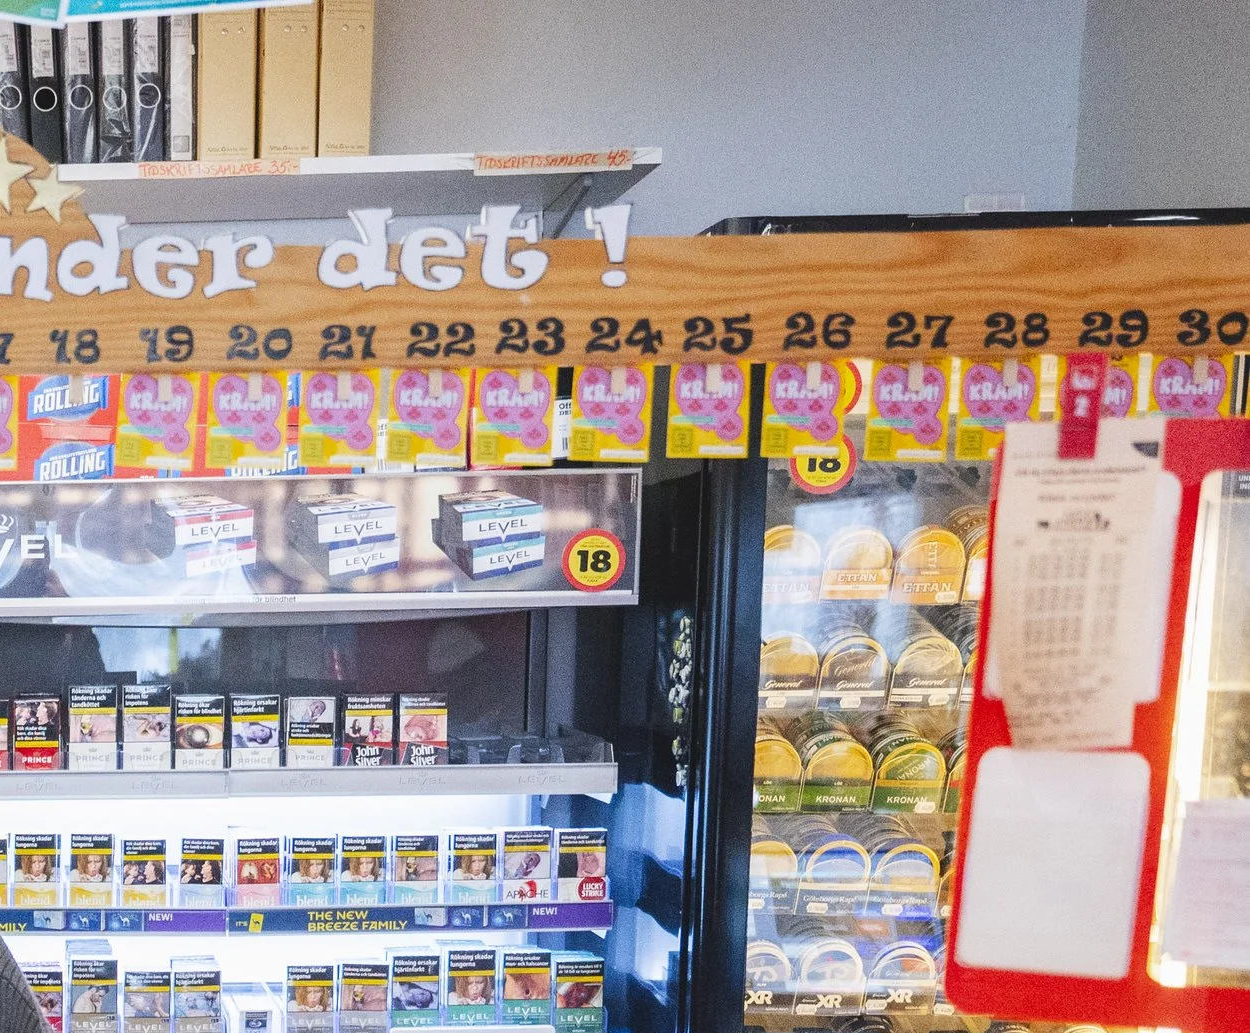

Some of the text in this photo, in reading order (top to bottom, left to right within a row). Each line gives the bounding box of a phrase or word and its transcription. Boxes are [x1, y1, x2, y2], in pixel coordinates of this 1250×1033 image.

[317, 205, 548, 291] det
[585, 202, 632, 288] !
[52, 329, 100, 364] 18
[141, 326, 194, 362] 19
[229, 324, 294, 360] 20
[317, 324, 377, 361] 21
[408, 323, 475, 356] 22
[496, 318, 564, 355] 23
[586, 318, 662, 354] 24
[684, 314, 753, 355] 25
[784, 312, 855, 350] 26
[886, 311, 954, 348] 27
[984, 312, 1049, 348] 28
[1079, 310, 1149, 348] 29
[1177, 309, 1247, 346] 30
[39, 451, 106, 481] ROLLING
[807, 457, 842, 474] 18
[191, 523, 239, 538] LEVEL
[333, 521, 383, 536] LEVEL
[478, 518, 529, 535] LEVEL
[345, 551, 387, 568] LEVEL
[489, 549, 531, 565] LEVEL
[577, 549, 612, 571] 18
[837, 573, 877, 583] ETTAN
[902, 582, 952, 593] ETTAN
[908, 677, 948, 688] General
[356, 746, 380, 757] John
[410, 746, 434, 757] John
[22, 756, 52, 764] PRINCE
[355, 756, 381, 766] Silver
[410, 755, 437, 765] Silver
[816, 795, 856, 804] KRONAN
[581, 883, 603, 891] LUCKY
[581, 890, 605, 898] STRIKE
[307, 910, 368, 921] THE NEW
[532, 907, 558, 916] NEW!
[149, 913, 174, 922] NEW!
[307, 920, 408, 932] BREEZE FAMILY
[887, 989, 913, 1004] XR
